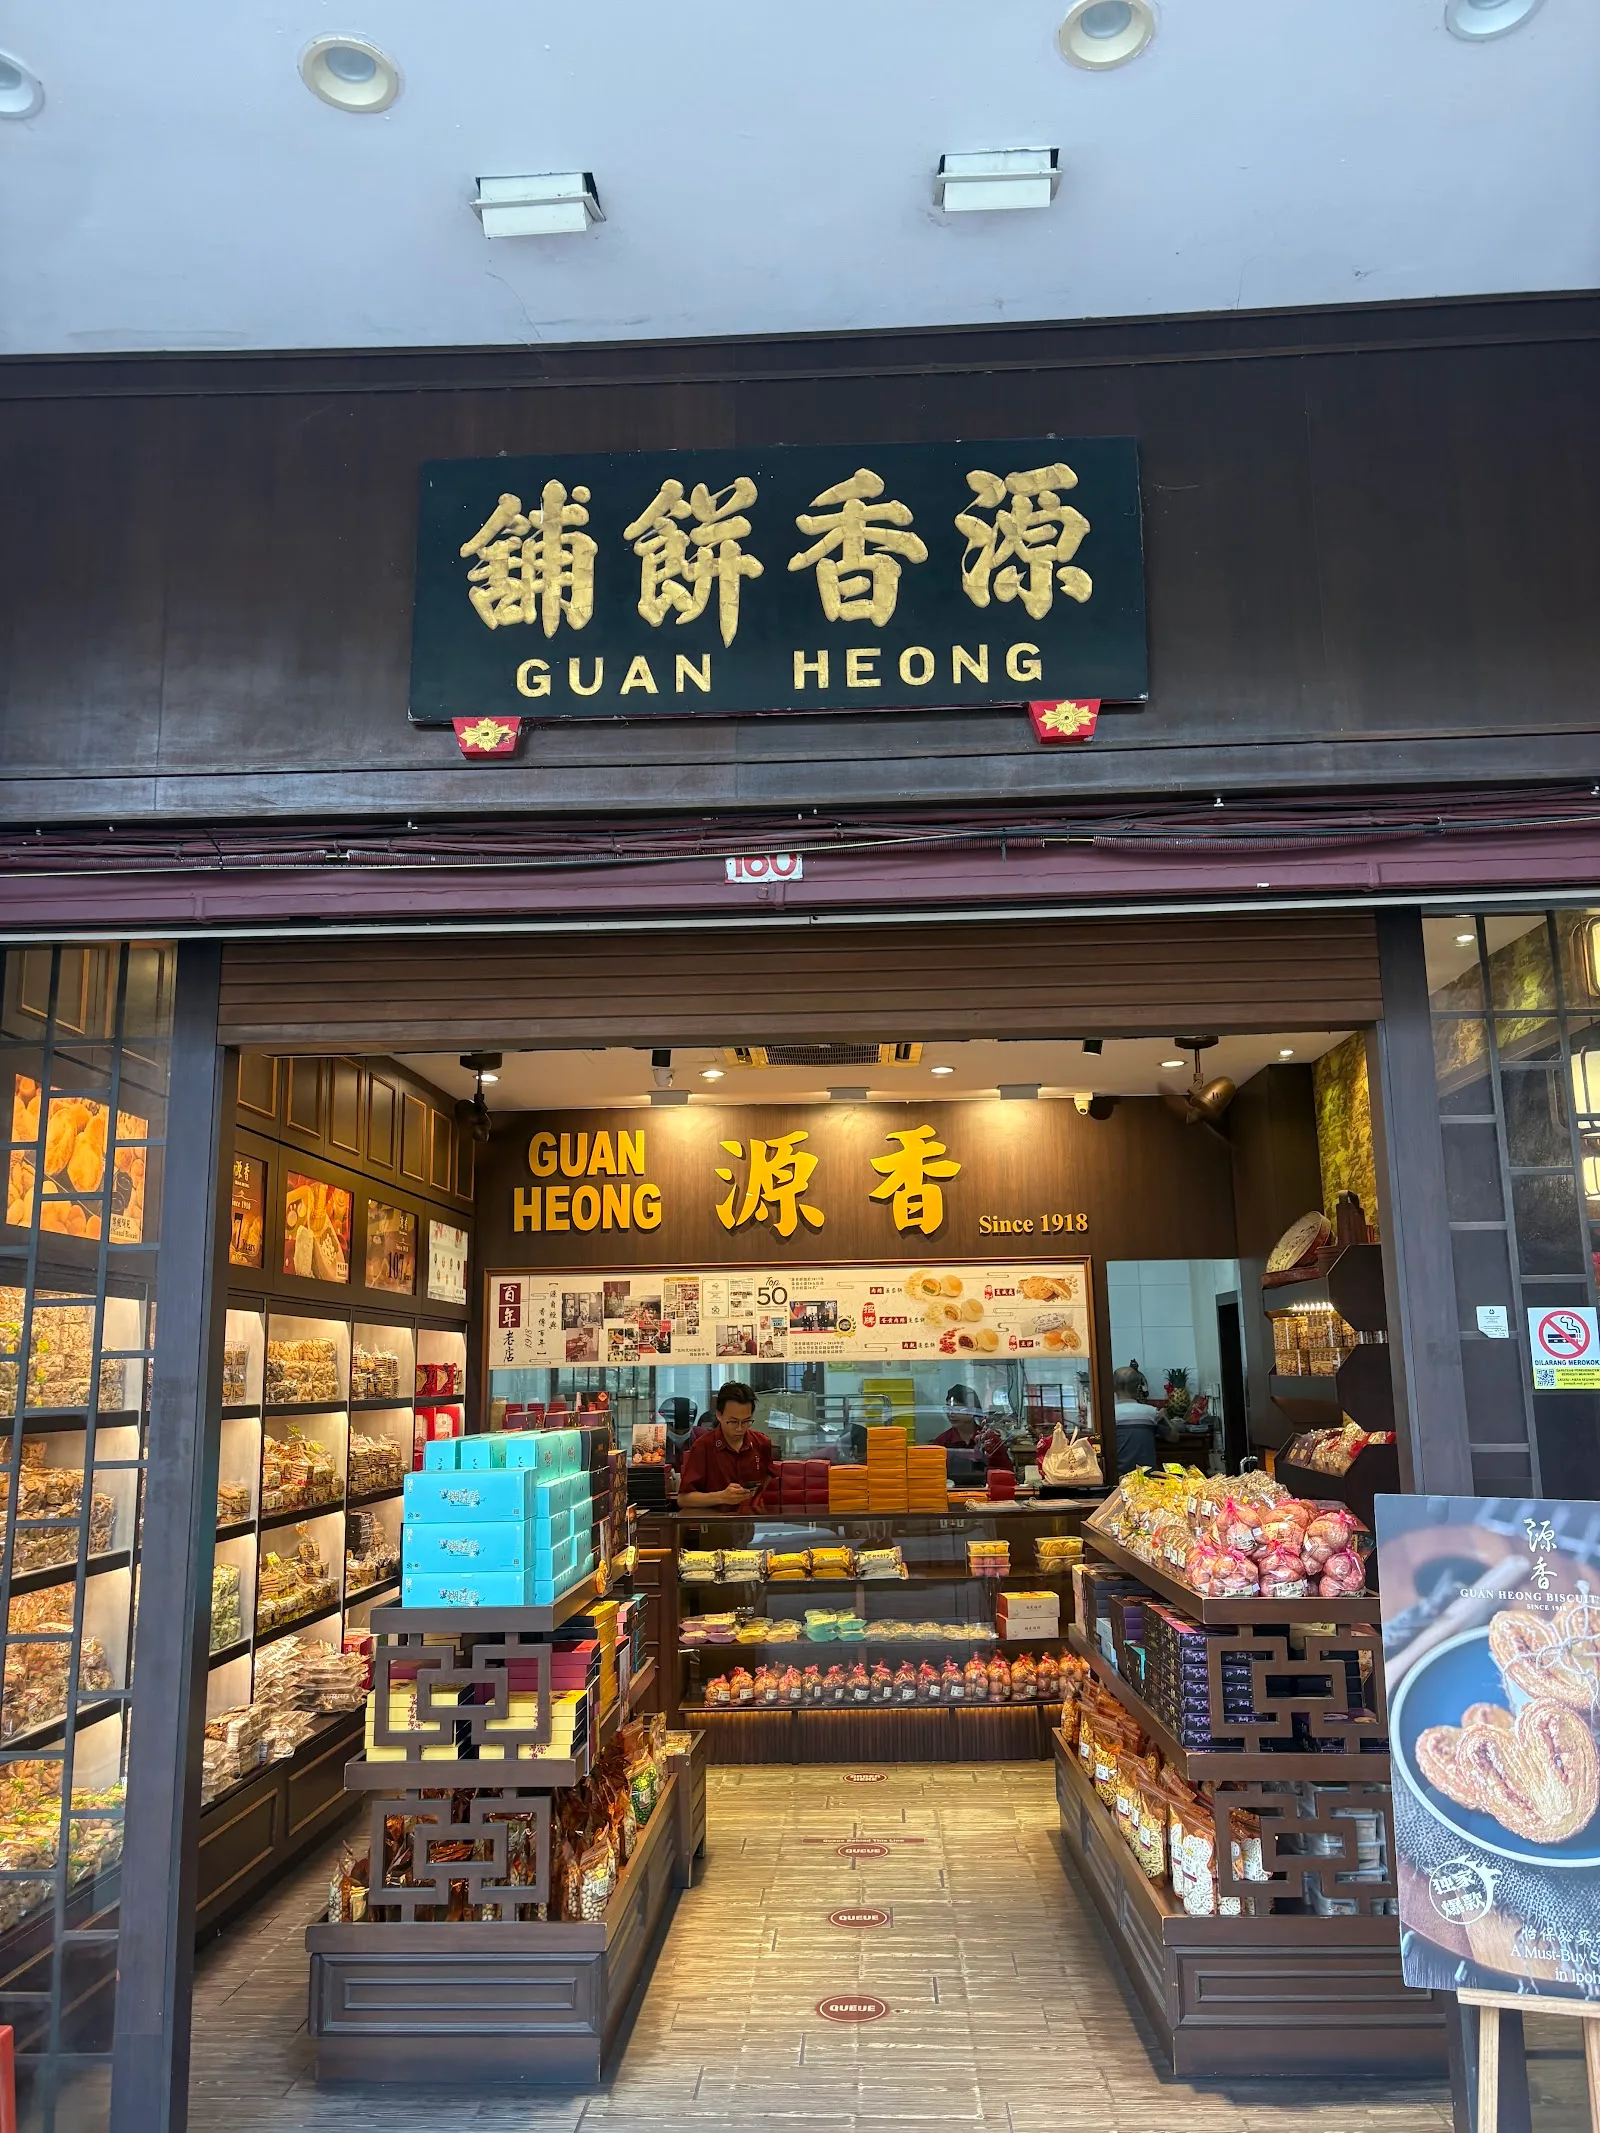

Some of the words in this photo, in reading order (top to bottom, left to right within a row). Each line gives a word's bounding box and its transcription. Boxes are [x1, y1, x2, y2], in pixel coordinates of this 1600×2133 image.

[515, 652, 713, 698] GUAN
[793, 641, 1043, 691] HEONG
[735, 854, 797, 877] 160
[528, 1129, 646, 1178] GUAN
[715, 1124, 961, 1237] 源香
[513, 1183, 662, 1232] HEONG
[978, 1214, 1035, 1236] Since
[1040, 1212, 1089, 1234] 1918
[765, 1276, 781, 1287] Top
[756, 1286, 788, 1306] 50
[502, 1284, 519, 1363] 百年老店
[1523, 1517, 1558, 1590] 源香
[1460, 1588, 1494, 1599] GUAN
[1498, 1590, 1542, 1602] HEONG
[1526, 1603, 1550, 1611] SINCE
[1432, 1868, 1476, 1895] 独家
[1441, 1890, 1486, 1918] 爆款
[1510, 1945, 1521, 1957] A
[1524, 1945, 1587, 1966] Must-Buy
[1555, 1968, 1568, 1982] in
[1571, 1970, 1600, 1986] Ipoh
[829, 2004, 877, 2013] QUEUE
